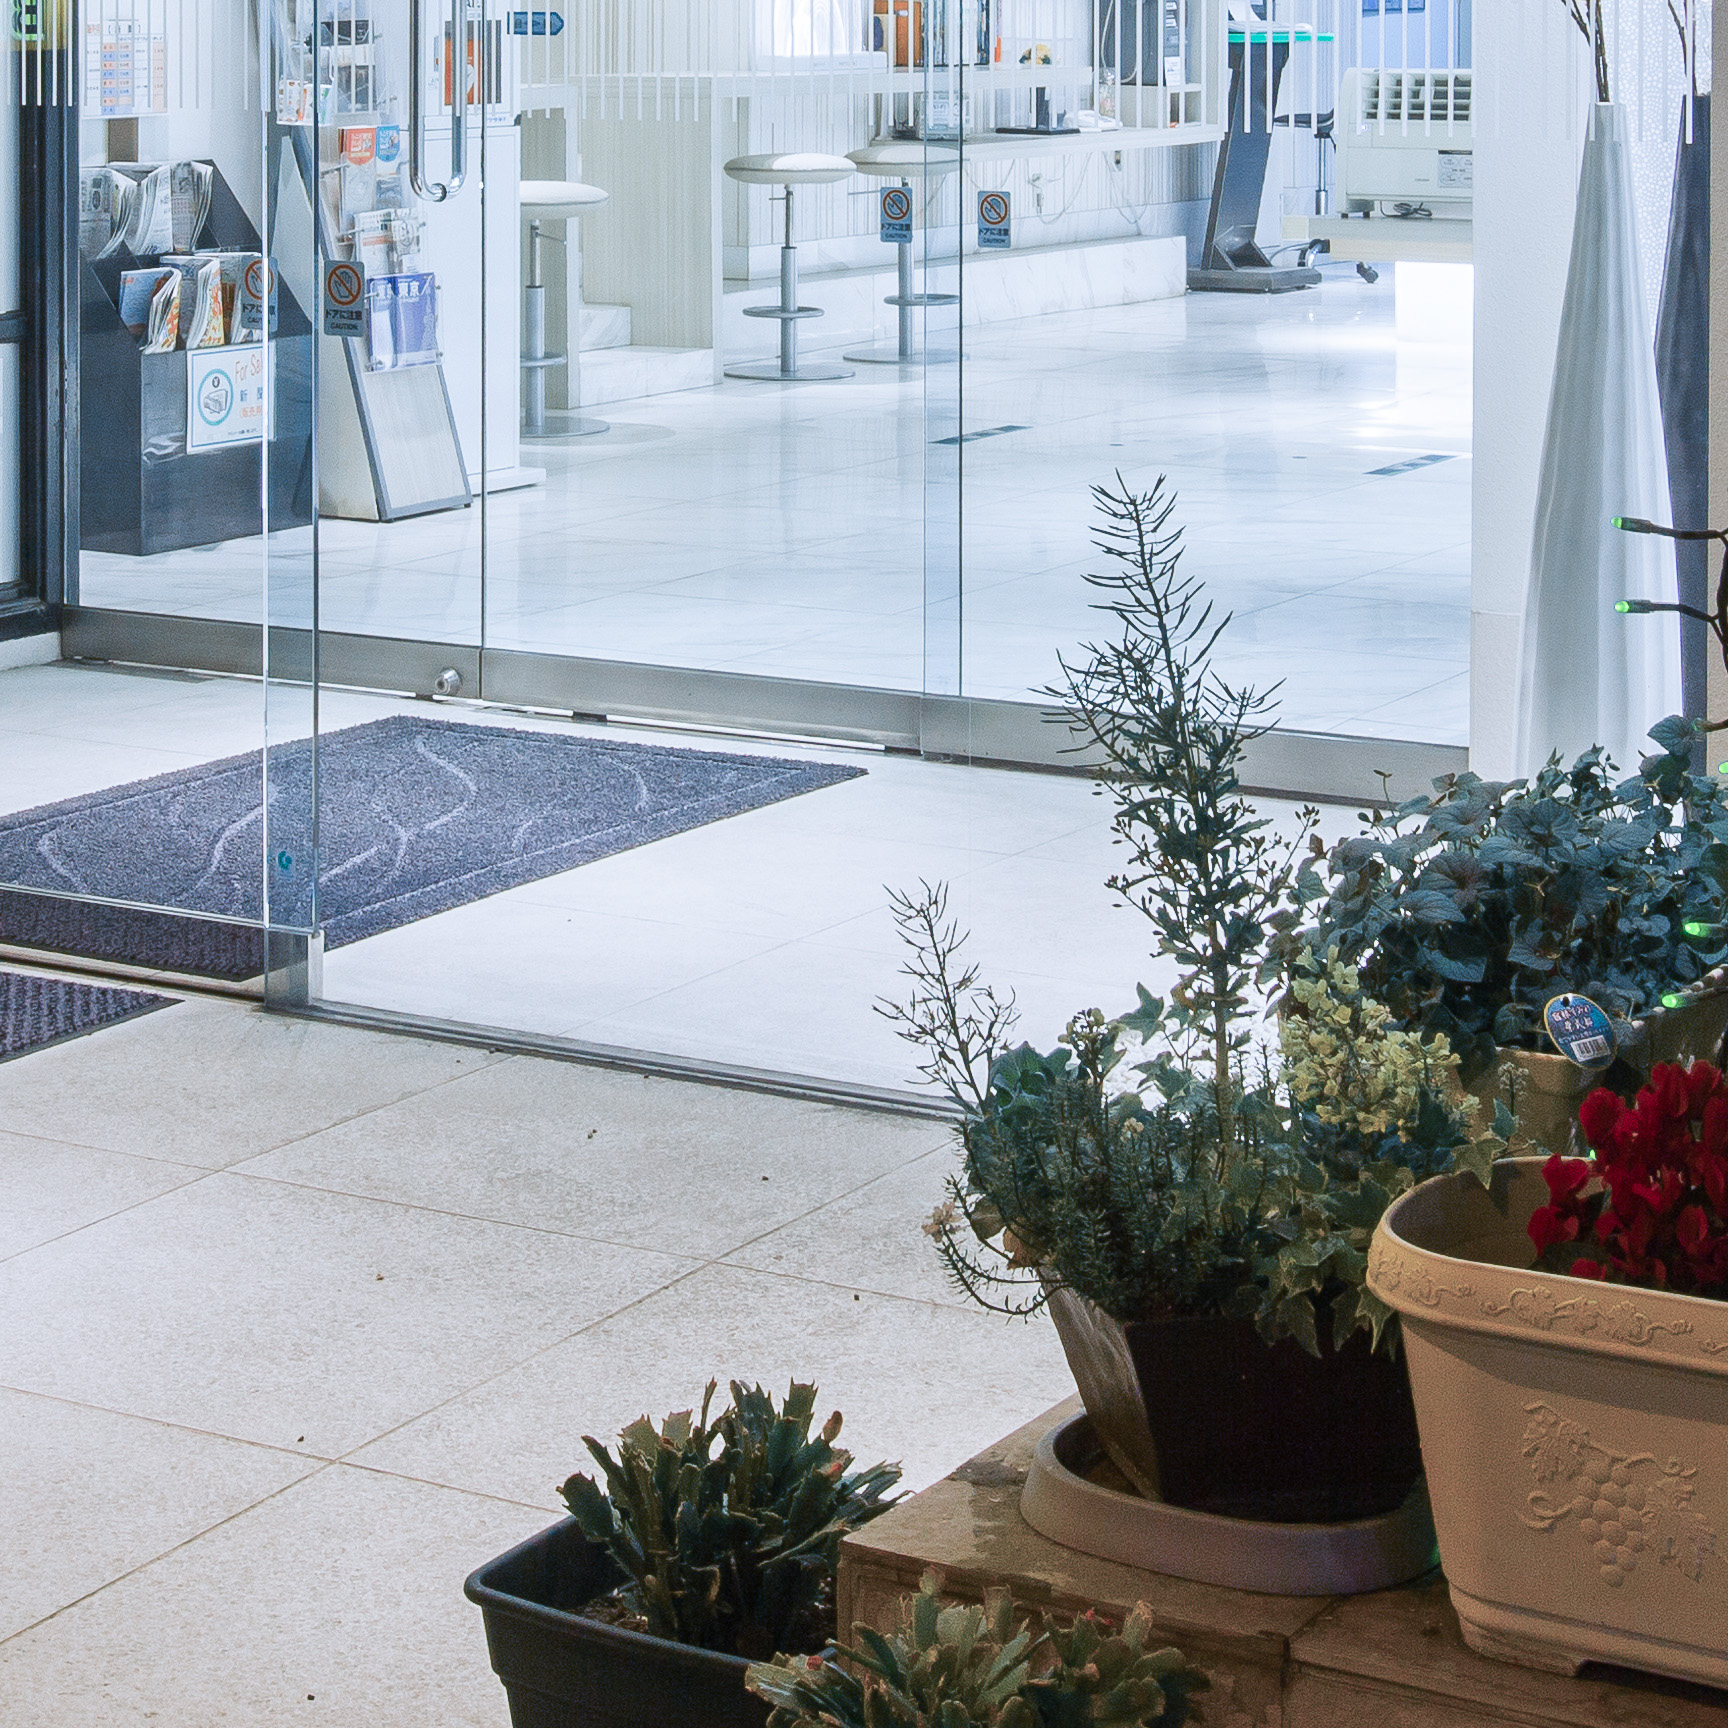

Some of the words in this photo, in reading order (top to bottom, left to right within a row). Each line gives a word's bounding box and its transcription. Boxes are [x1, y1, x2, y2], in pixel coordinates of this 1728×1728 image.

[398, 280, 420, 297] 東京
[325, 309, 363, 321] ドアに注意
[330, 322, 359, 331] CAUTION
